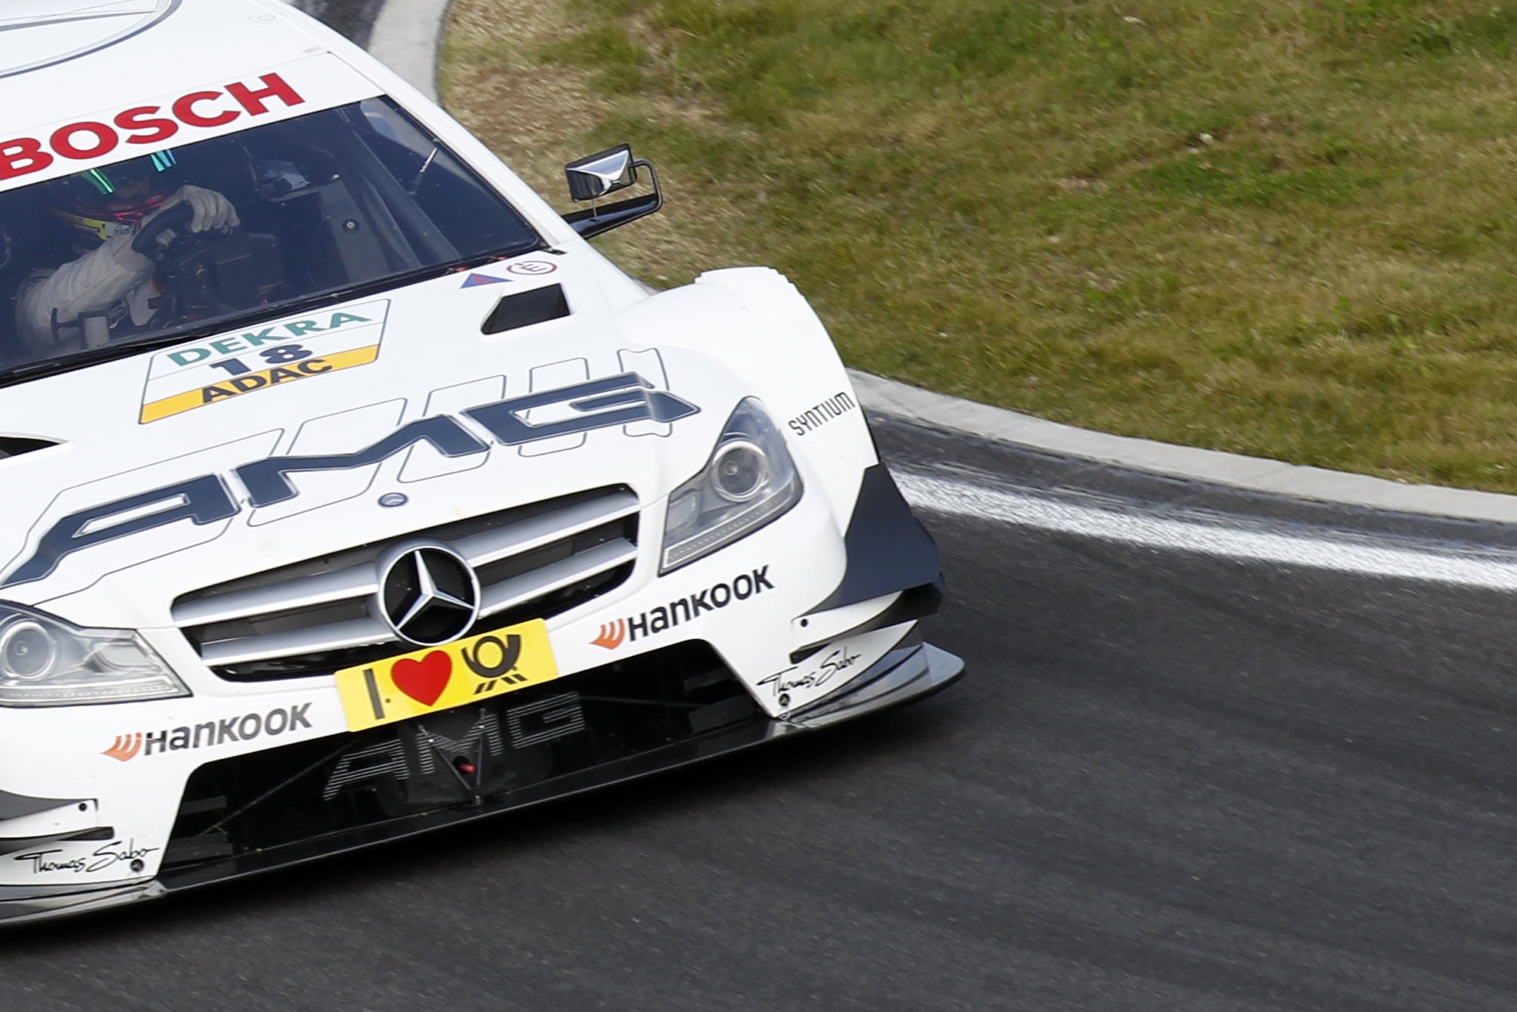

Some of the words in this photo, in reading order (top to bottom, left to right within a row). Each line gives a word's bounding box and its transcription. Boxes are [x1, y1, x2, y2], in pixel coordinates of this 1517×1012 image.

[167, 312, 372, 367] DEKRA
[209, 344, 312, 376] 18
[202, 359, 333, 403] ADAC
[788, 391, 856, 436] SYNTIUM
[363, 668, 385, 720] I
[323, 690, 586, 802] AMG
[14, 849, 86, 874] Thomas
[86, 837, 160, 873] Sabo
